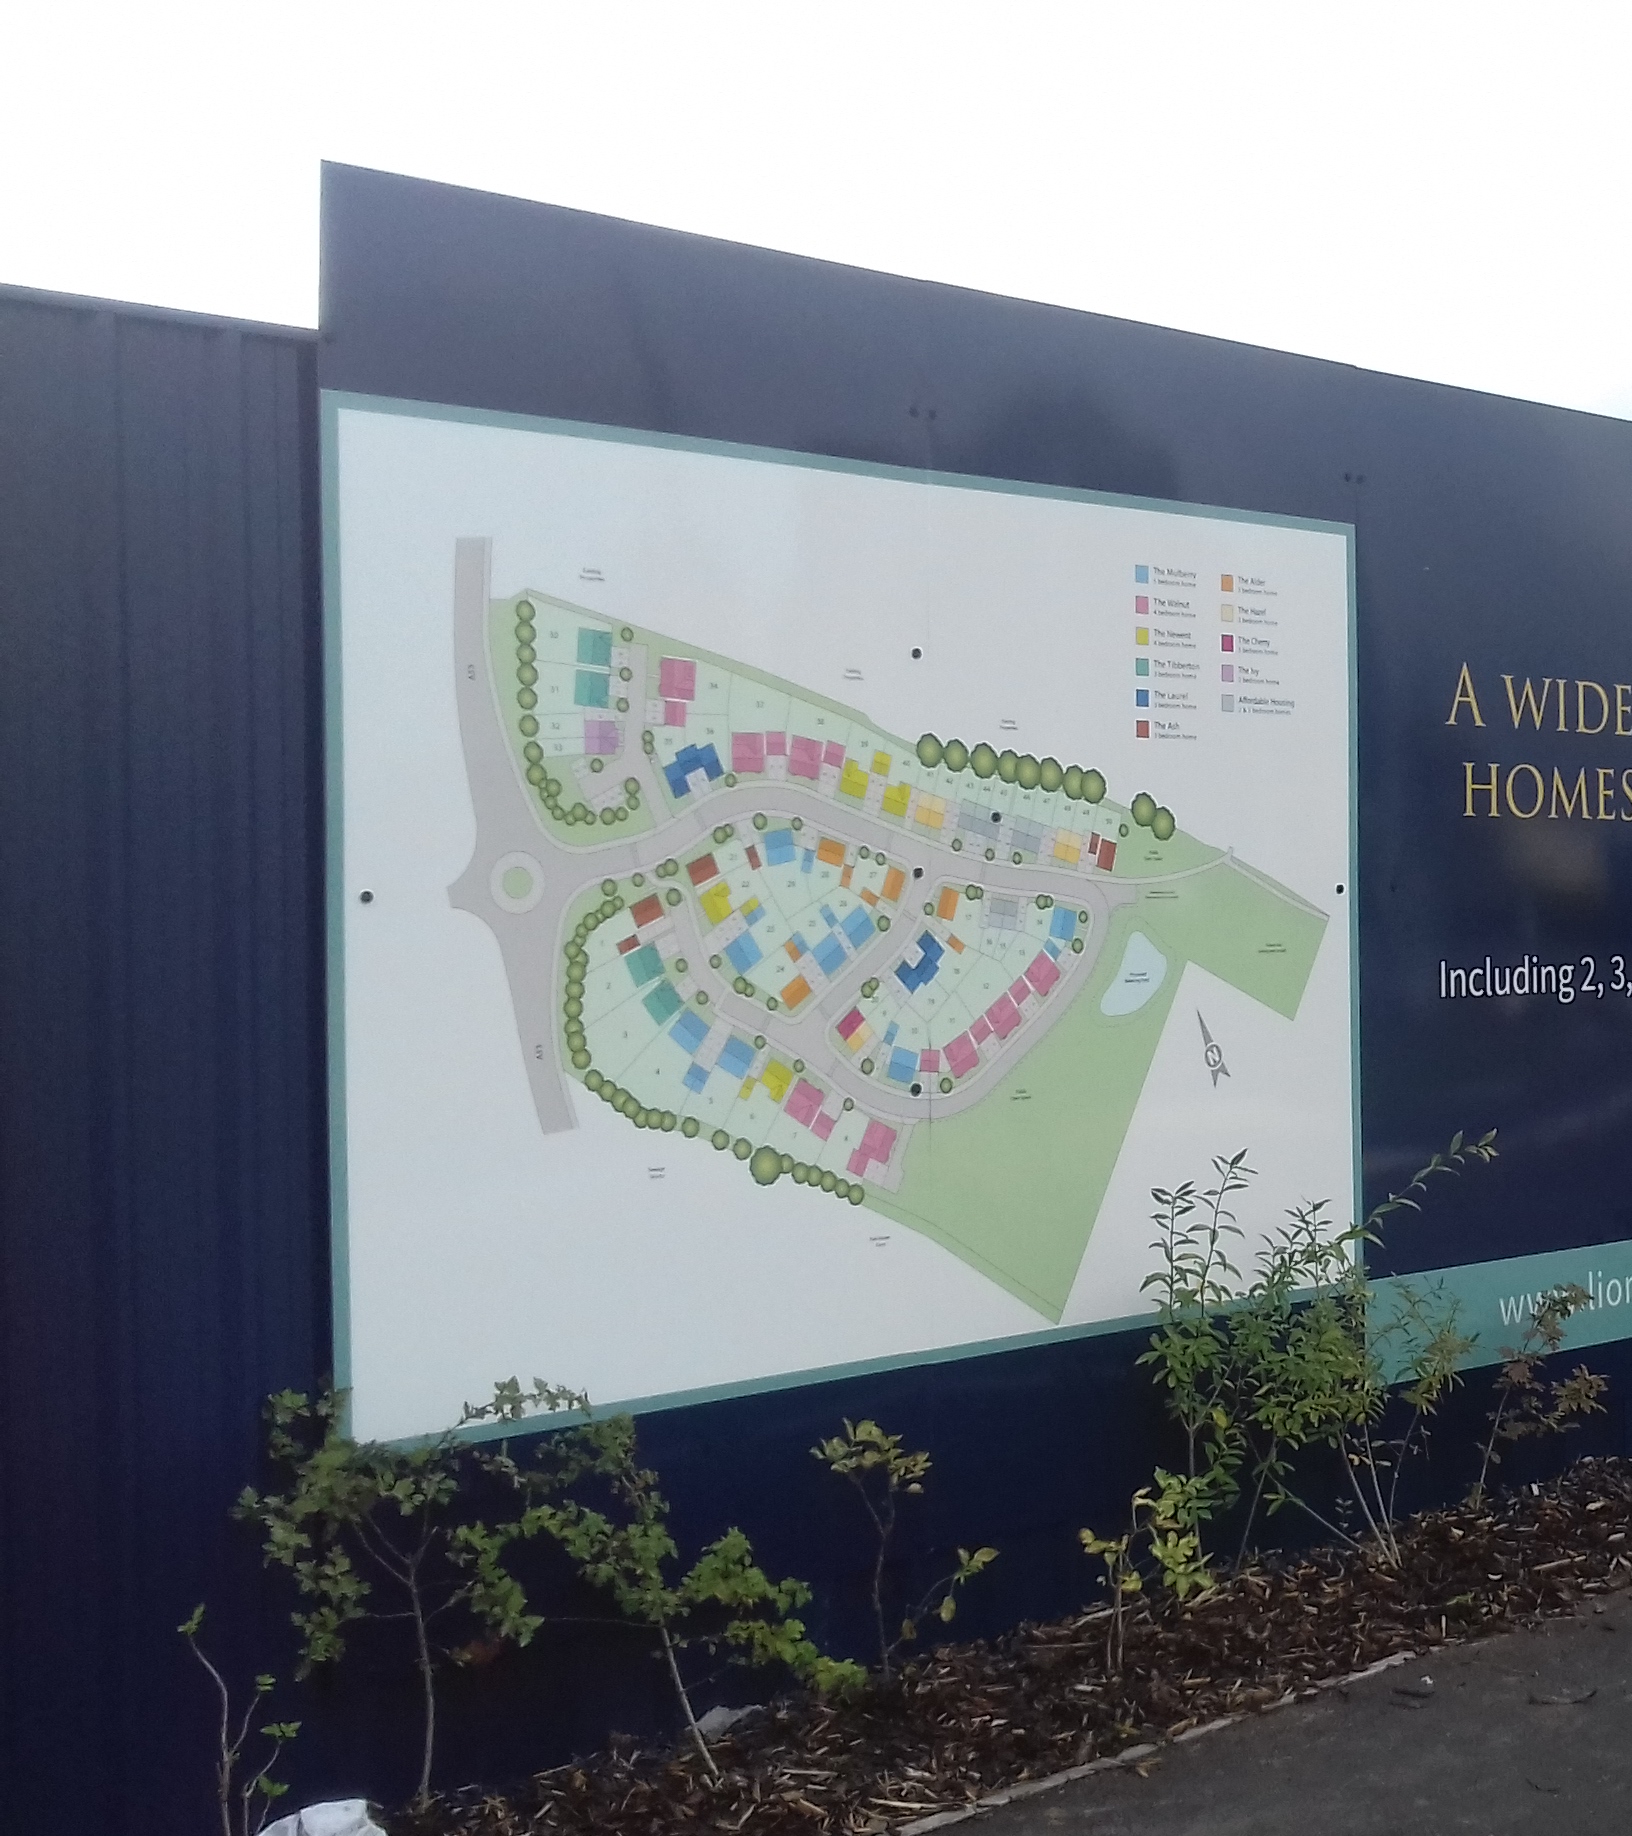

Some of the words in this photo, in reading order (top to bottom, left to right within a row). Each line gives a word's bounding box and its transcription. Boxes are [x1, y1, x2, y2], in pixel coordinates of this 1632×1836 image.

[1445, 662, 1487, 727] A
[1501, 674, 1632, 736] WIDE
[1440, 955, 1575, 1003] Including
[1580, 956, 1604, 999] 2,
[1610, 955, 1632, 998] 3,
